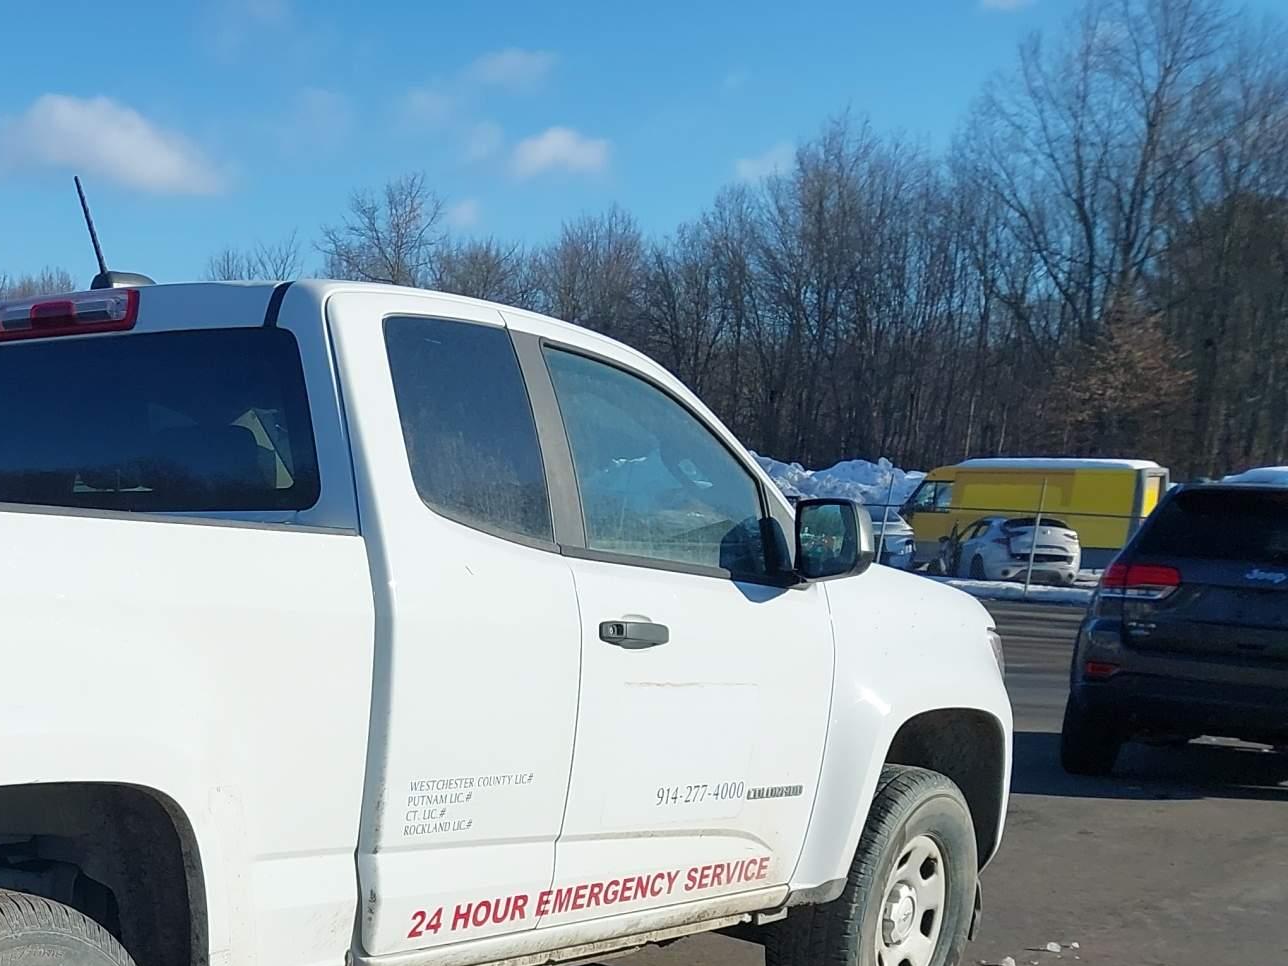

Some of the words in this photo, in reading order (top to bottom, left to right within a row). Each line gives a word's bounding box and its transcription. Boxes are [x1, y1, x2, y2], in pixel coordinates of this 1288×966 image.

[410, 777, 475, 792] WESTCHESTER
[477, 774, 513, 788] COUNTY
[407, 794, 448, 807] PUTNAM
[656, 781, 745, 806] 914-277-4000
[403, 821, 451, 836] ROCKLAND
[407, 909, 442, 938] 24
[450, 894, 529, 931] HOUR
[534, 869, 681, 917] EMERGENCY
[683, 856, 771, 891] SERVICE
